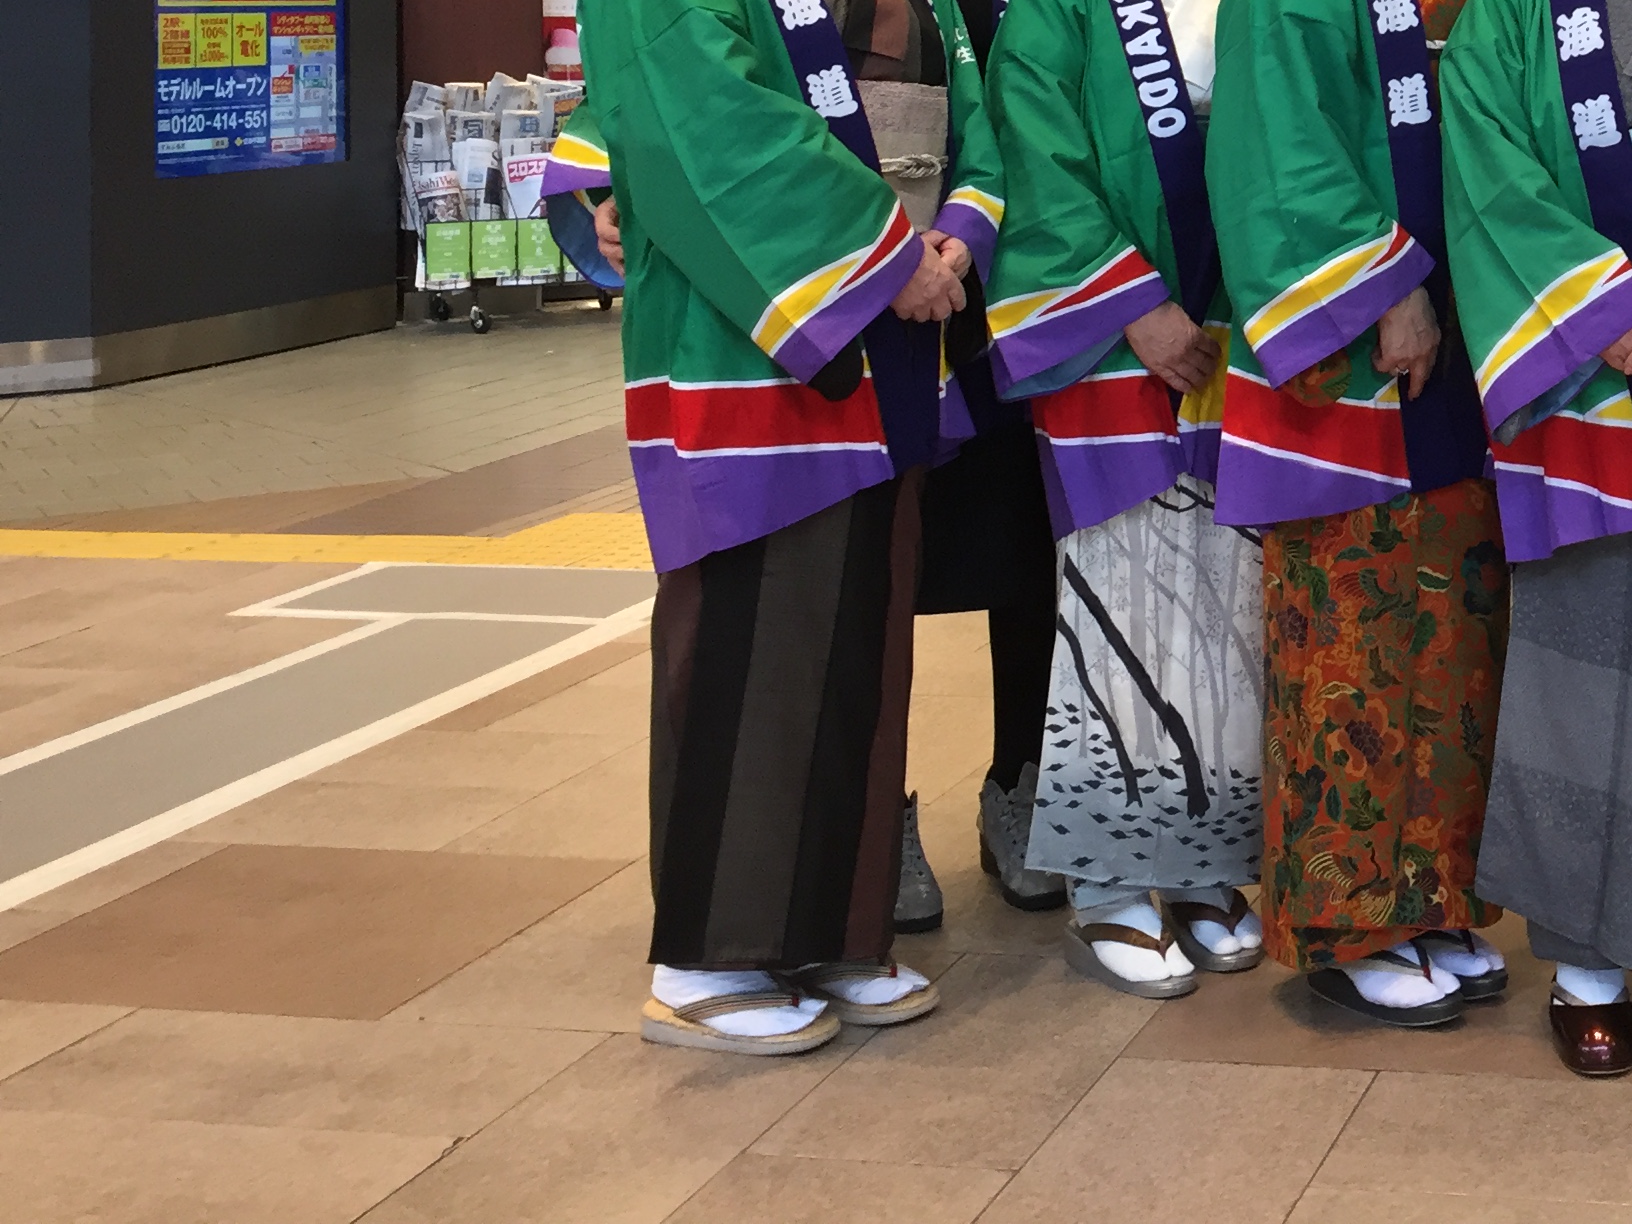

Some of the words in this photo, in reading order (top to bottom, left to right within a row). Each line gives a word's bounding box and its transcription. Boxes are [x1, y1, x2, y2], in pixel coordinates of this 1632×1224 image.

[236, 21, 264, 38] オール
[158, 74, 267, 102] モデルルームオープン
[171, 110, 268, 134] 0120-414-551
